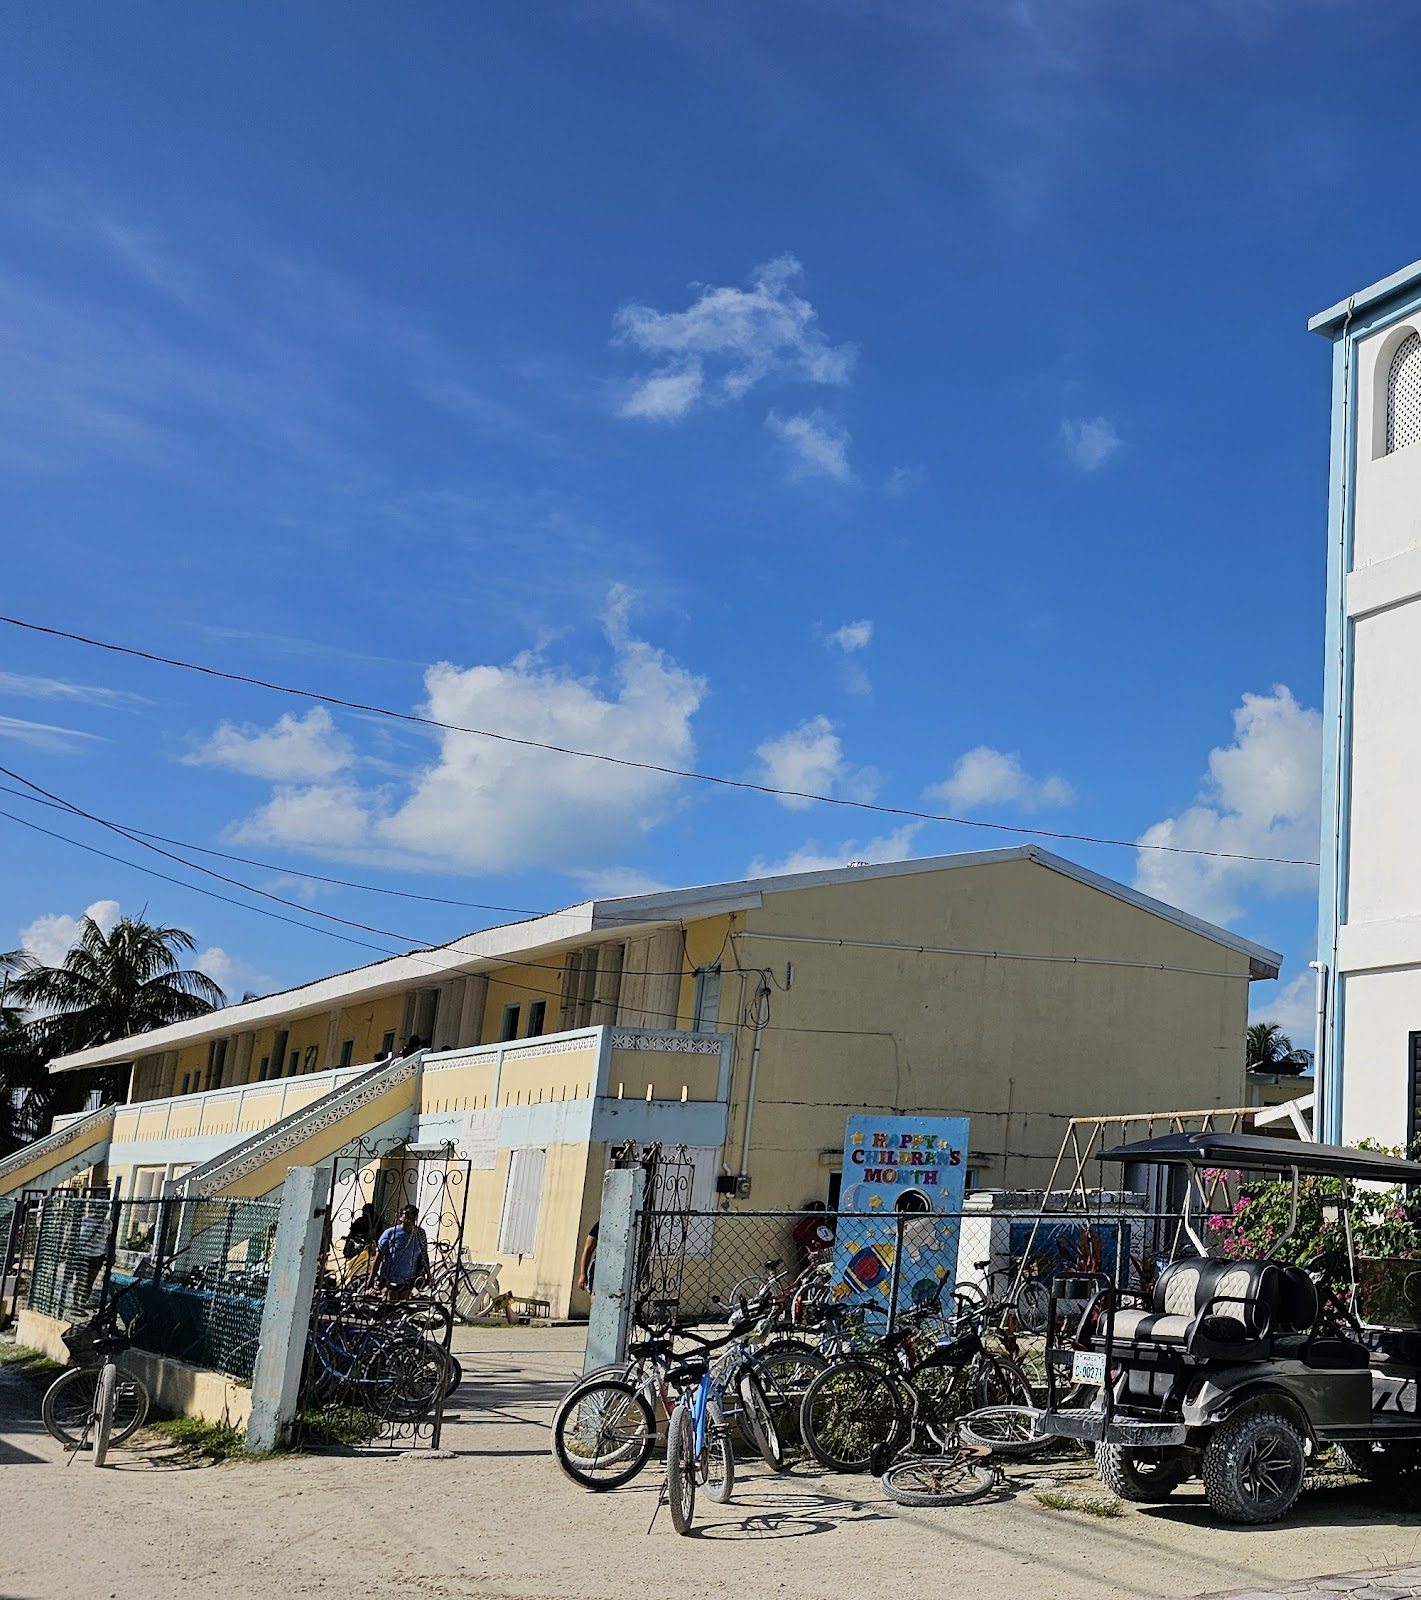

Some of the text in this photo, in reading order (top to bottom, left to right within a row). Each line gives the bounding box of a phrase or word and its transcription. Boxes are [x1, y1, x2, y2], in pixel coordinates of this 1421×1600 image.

[872, 1133, 938, 1149] HAPPY
[851, 1148, 961, 1166] CHILDREN'S
[863, 1168, 939, 1185] MONTH
